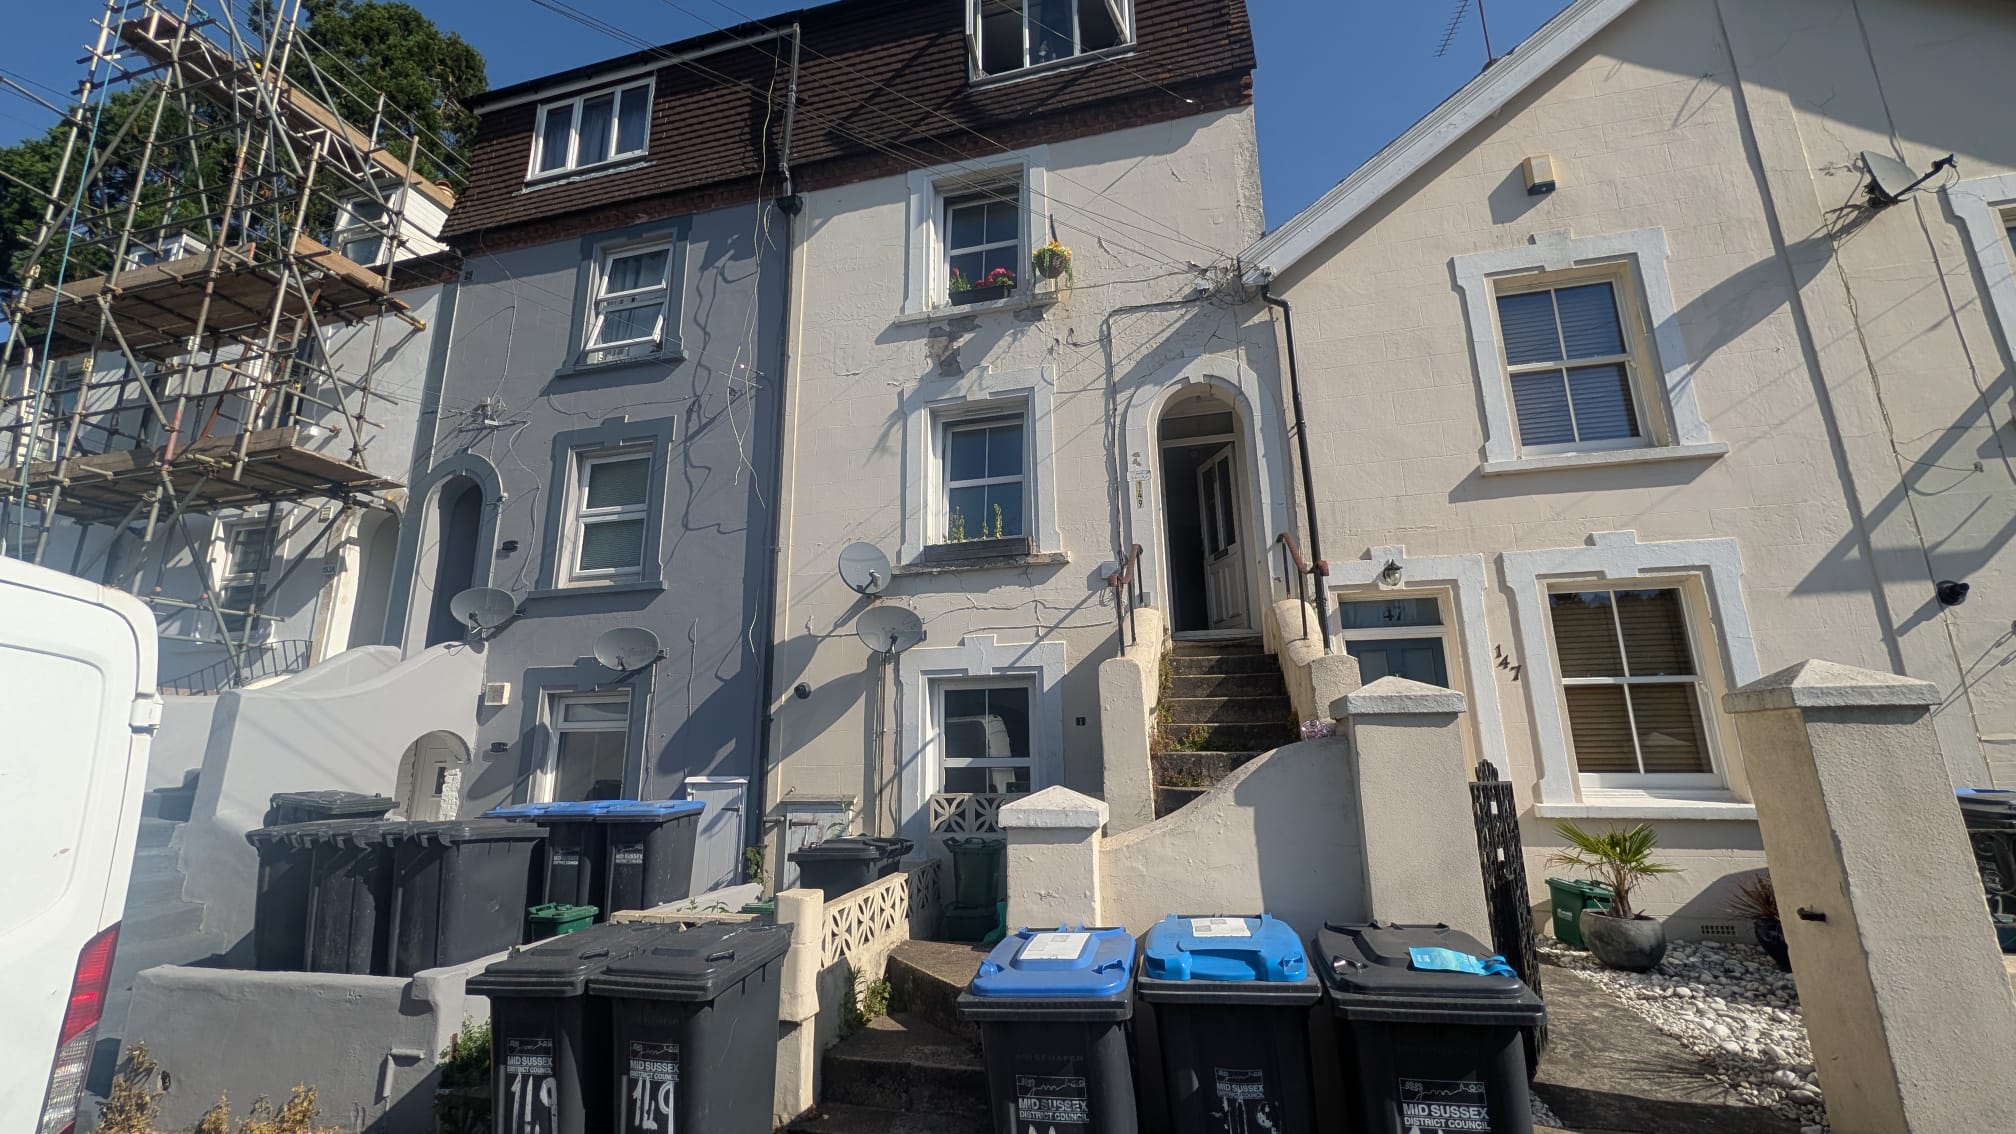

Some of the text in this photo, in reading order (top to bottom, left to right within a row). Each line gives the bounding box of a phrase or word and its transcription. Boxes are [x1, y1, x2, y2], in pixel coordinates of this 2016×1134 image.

[1494, 643, 1522, 682] 147
[507, 1055, 553, 1066] MID SUSSEX
[630, 1060, 680, 1073] MID SUSSEX
[529, 1066, 553, 1074] COUNCIL
[1216, 1083, 1264, 1092] MID SUSSEX
[1018, 1097, 1089, 1111] MID SUSSEX
[1019, 1110, 1089, 1121] DISTRICT COUNCIL
[1402, 1103, 1489, 1119] MID SUSSEX
[1404, 1117, 1446, 1127] DISTRICT
[1448, 1119, 1492, 1130] COUNCIL
